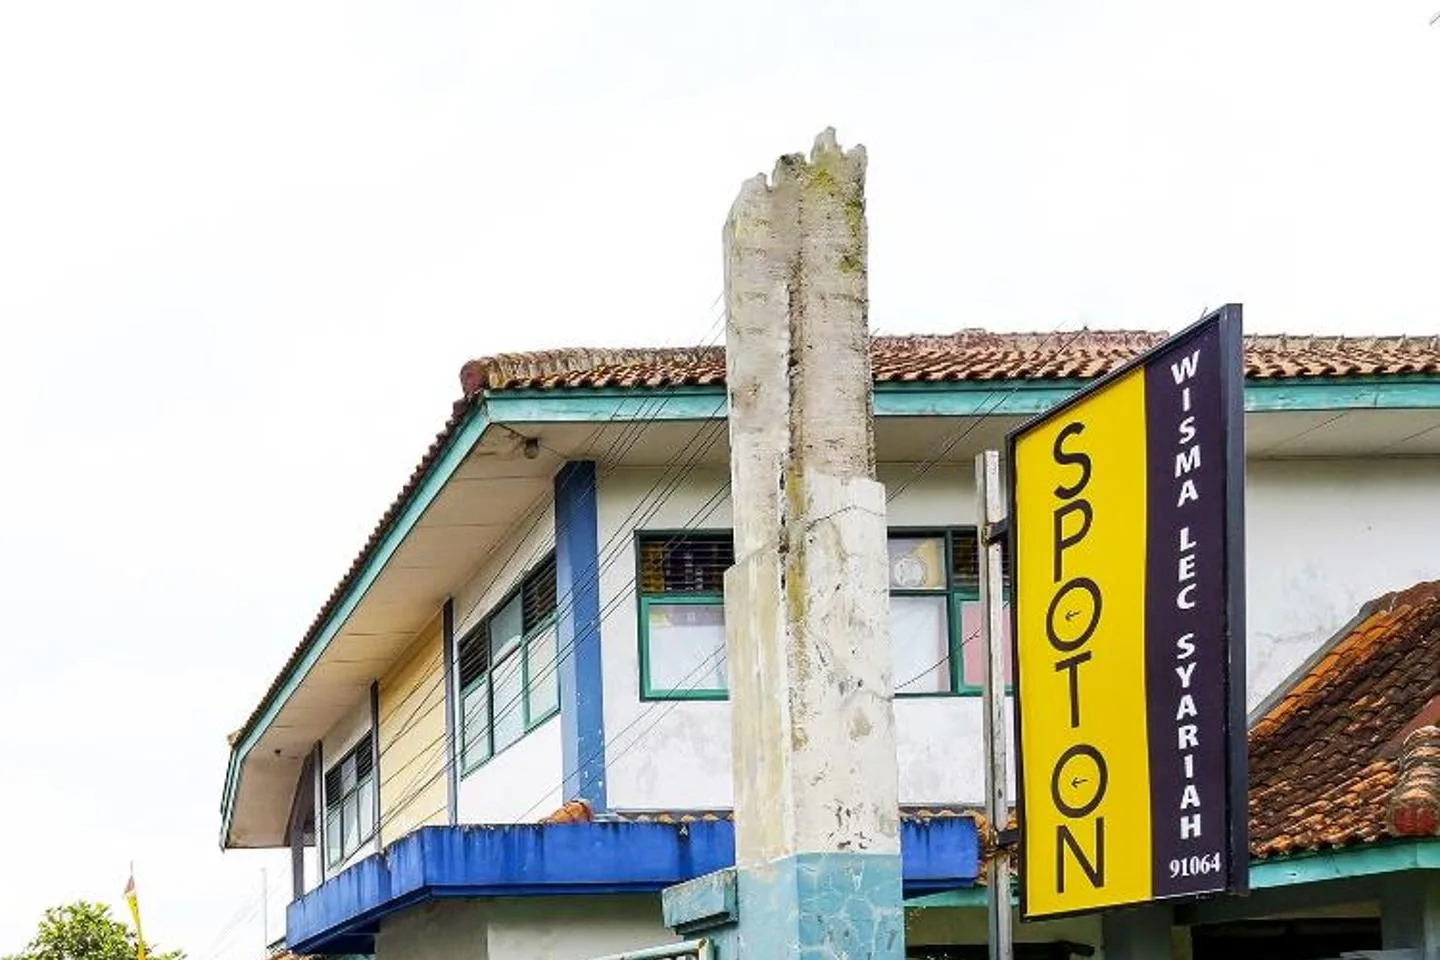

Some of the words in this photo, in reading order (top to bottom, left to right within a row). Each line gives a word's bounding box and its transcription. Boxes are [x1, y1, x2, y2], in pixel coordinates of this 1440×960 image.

[1171, 349, 1202, 508] WISMA
[1176, 526, 1197, 611] LEC
[1175, 632, 1202, 841] SYARIAH
[1169, 852, 1222, 879] 91064
